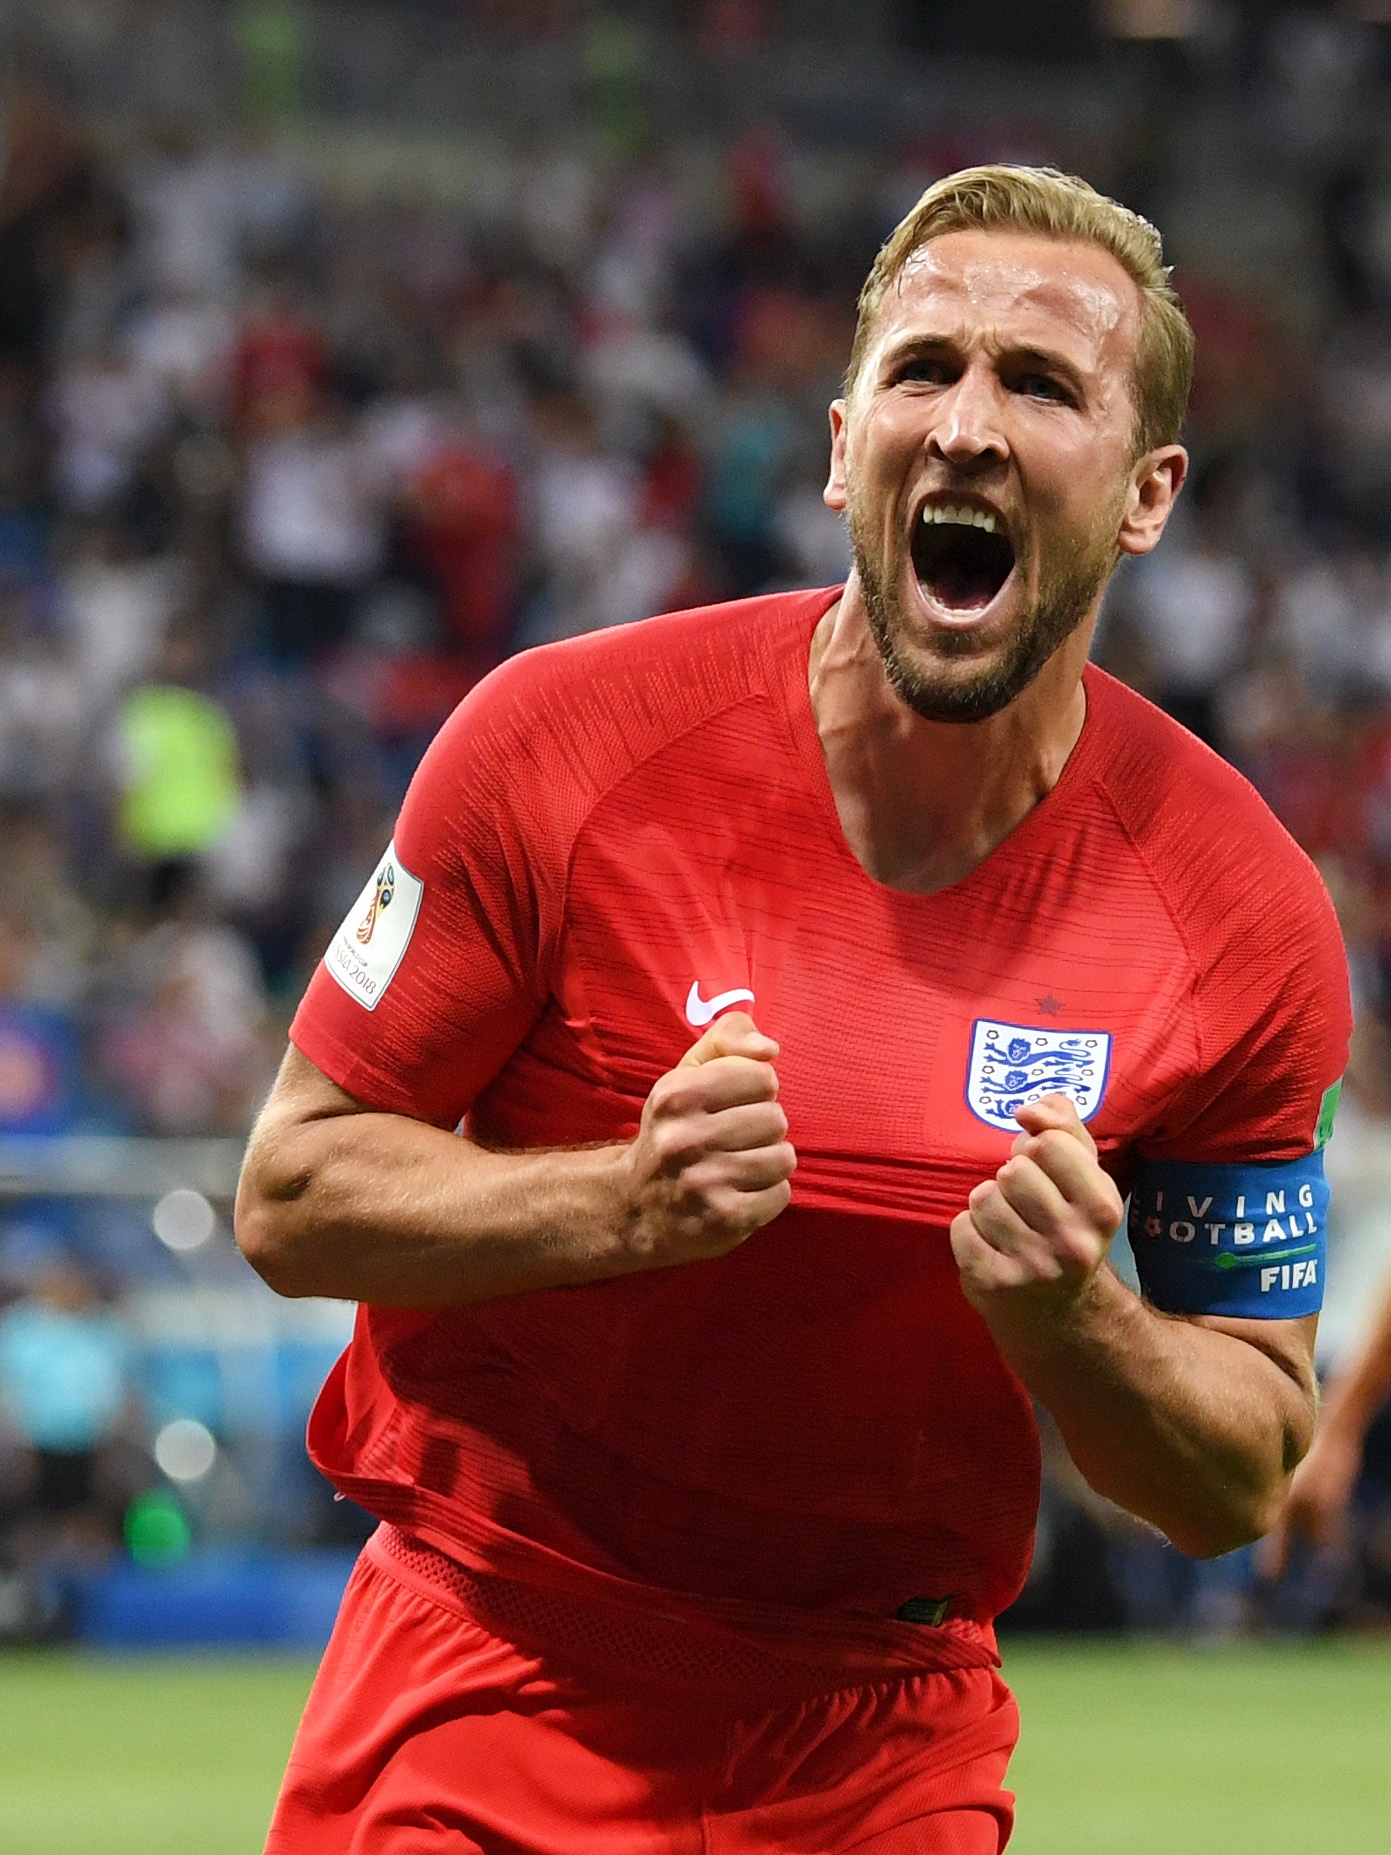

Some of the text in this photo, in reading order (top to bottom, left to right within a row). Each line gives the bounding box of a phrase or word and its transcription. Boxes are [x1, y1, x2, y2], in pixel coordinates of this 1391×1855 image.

[348, 965, 377, 995] 2018
[1155, 1184, 1314, 1219] IVING
[1140, 1211, 1319, 1246] OOTBALL
[1260, 1258, 1318, 1293] FIFA
